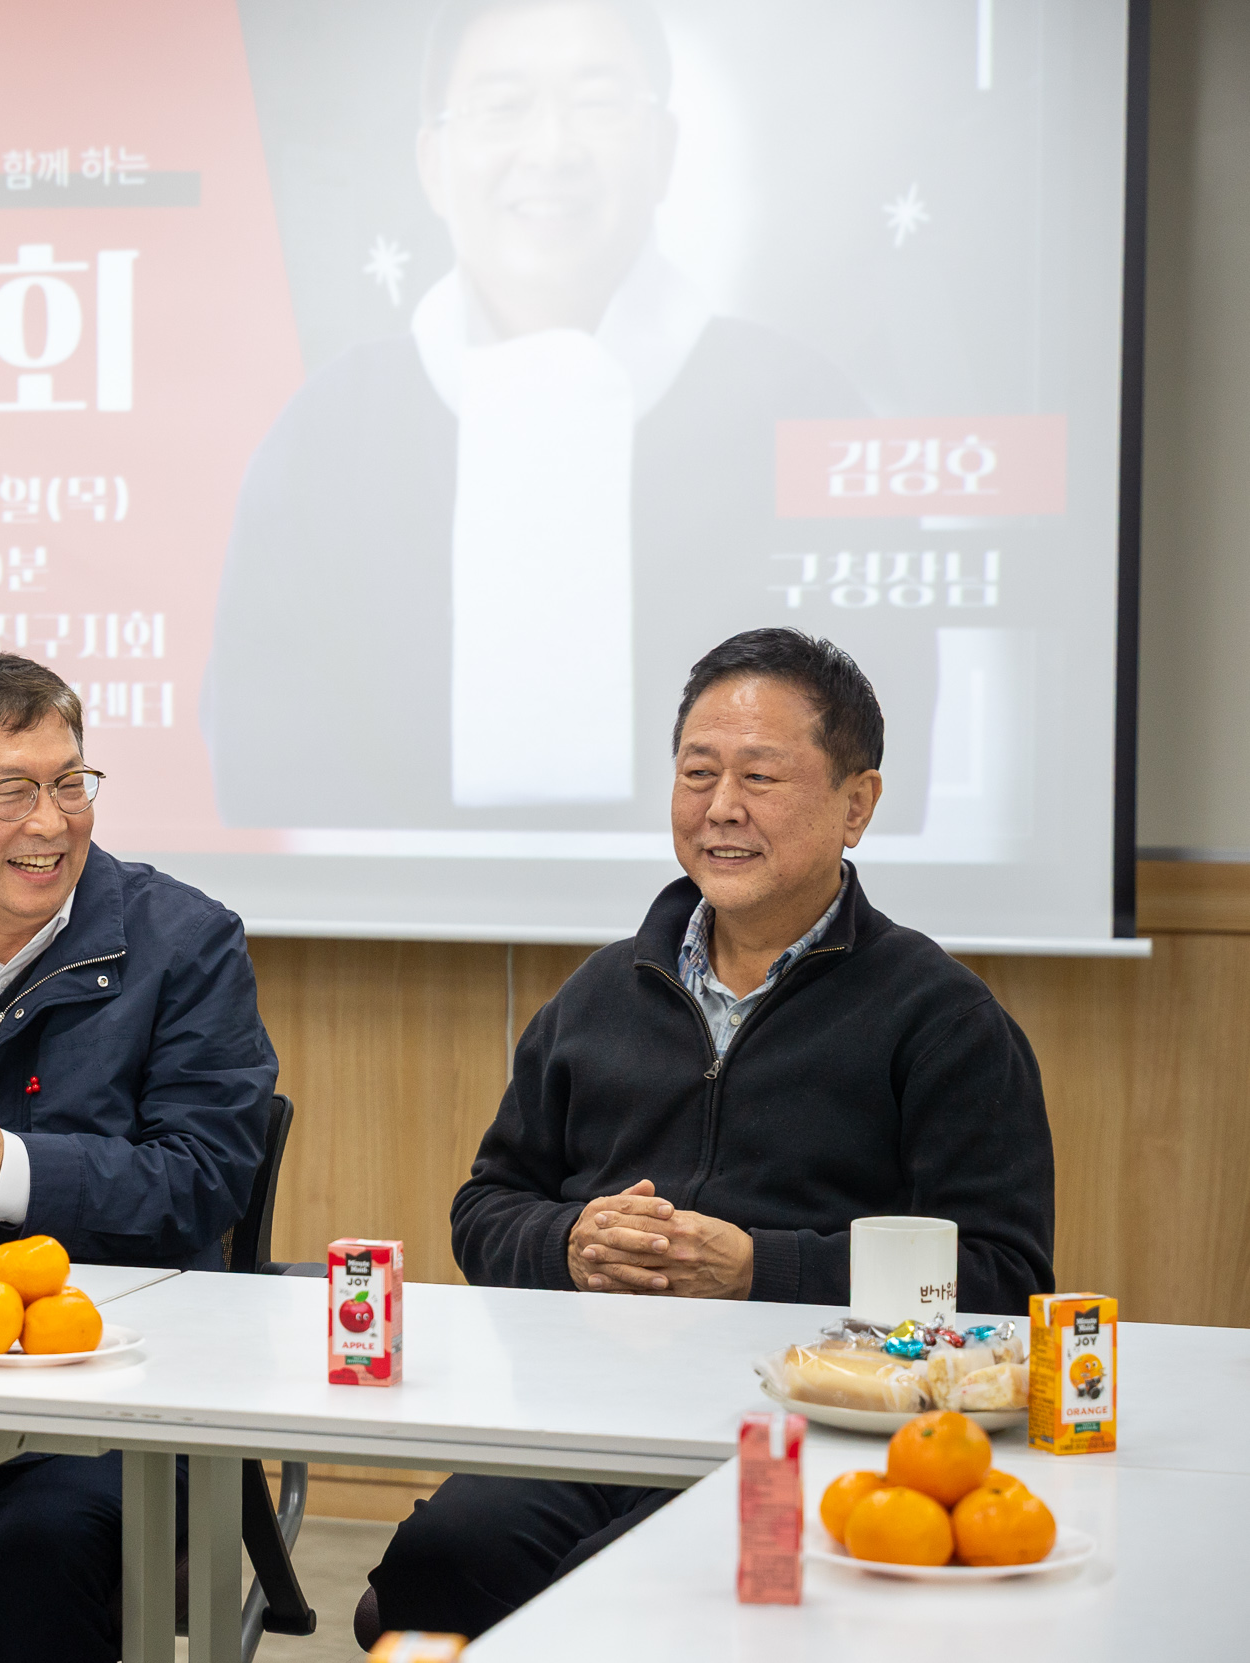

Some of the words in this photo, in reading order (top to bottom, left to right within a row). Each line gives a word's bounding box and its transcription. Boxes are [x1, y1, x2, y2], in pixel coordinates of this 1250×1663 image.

[2, 149, 68, 190] 함께
[80, 146, 150, 187] 하는
[827, 434, 998, 497] 김경호
[767, 549, 1001, 609] 구청장님
[347, 1278, 370, 1286] JOY
[342, 1341, 374, 1350] APPLE
[1075, 1336, 1097, 1347] JOY
[1066, 1406, 1108, 1417] ORANGE
